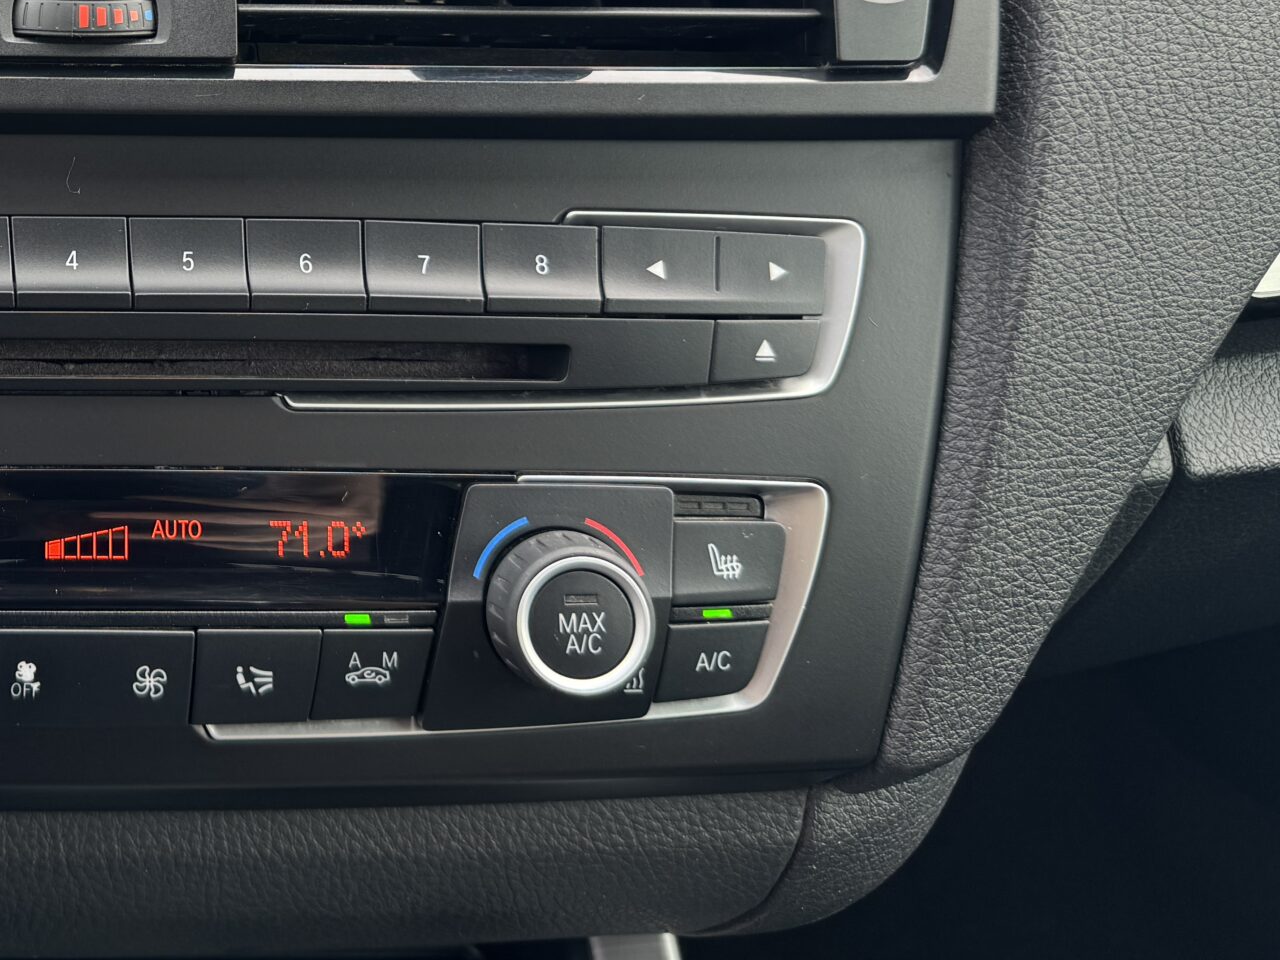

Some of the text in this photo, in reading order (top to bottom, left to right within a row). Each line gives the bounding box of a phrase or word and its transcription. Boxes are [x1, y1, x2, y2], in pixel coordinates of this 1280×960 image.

[65, 250, 80, 271] 4
[181, 251, 195, 273] 5
[299, 253, 313, 274] 6
[418, 254, 432, 275] 7
[535, 254, 549, 275] 8
[151, 519, 202, 541] AUTO
[558, 612, 606, 635] MAX
[566, 632, 602, 657] A/C
[349, 652, 361, 669] A
[382, 651, 398, 669] M
[695, 652, 732, 673] A/C
[11, 682, 40, 697] OFF
